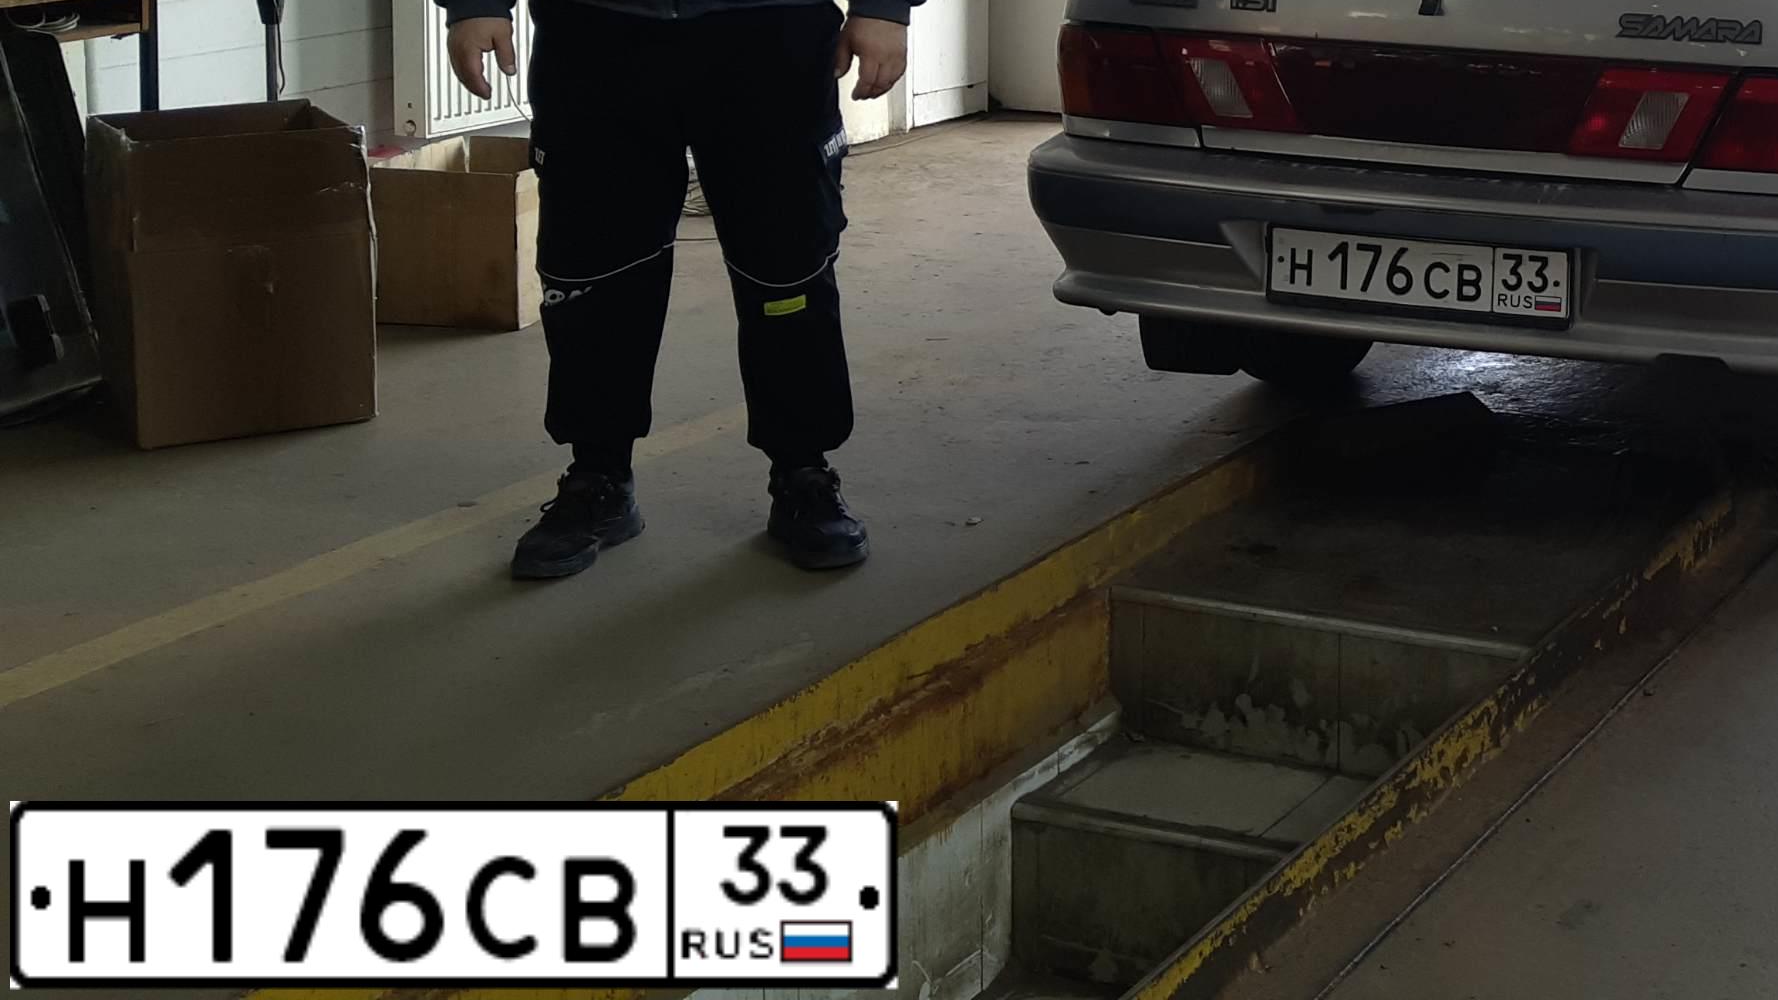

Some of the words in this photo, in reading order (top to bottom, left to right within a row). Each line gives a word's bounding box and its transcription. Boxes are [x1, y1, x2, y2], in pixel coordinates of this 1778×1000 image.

[1615, 13, 1763, 45] SAMARA
[1289, 240, 1483, 302] Н176СВ
[1501, 253, 1549, 294] 33
[1497, 294, 1533, 309] RUS
